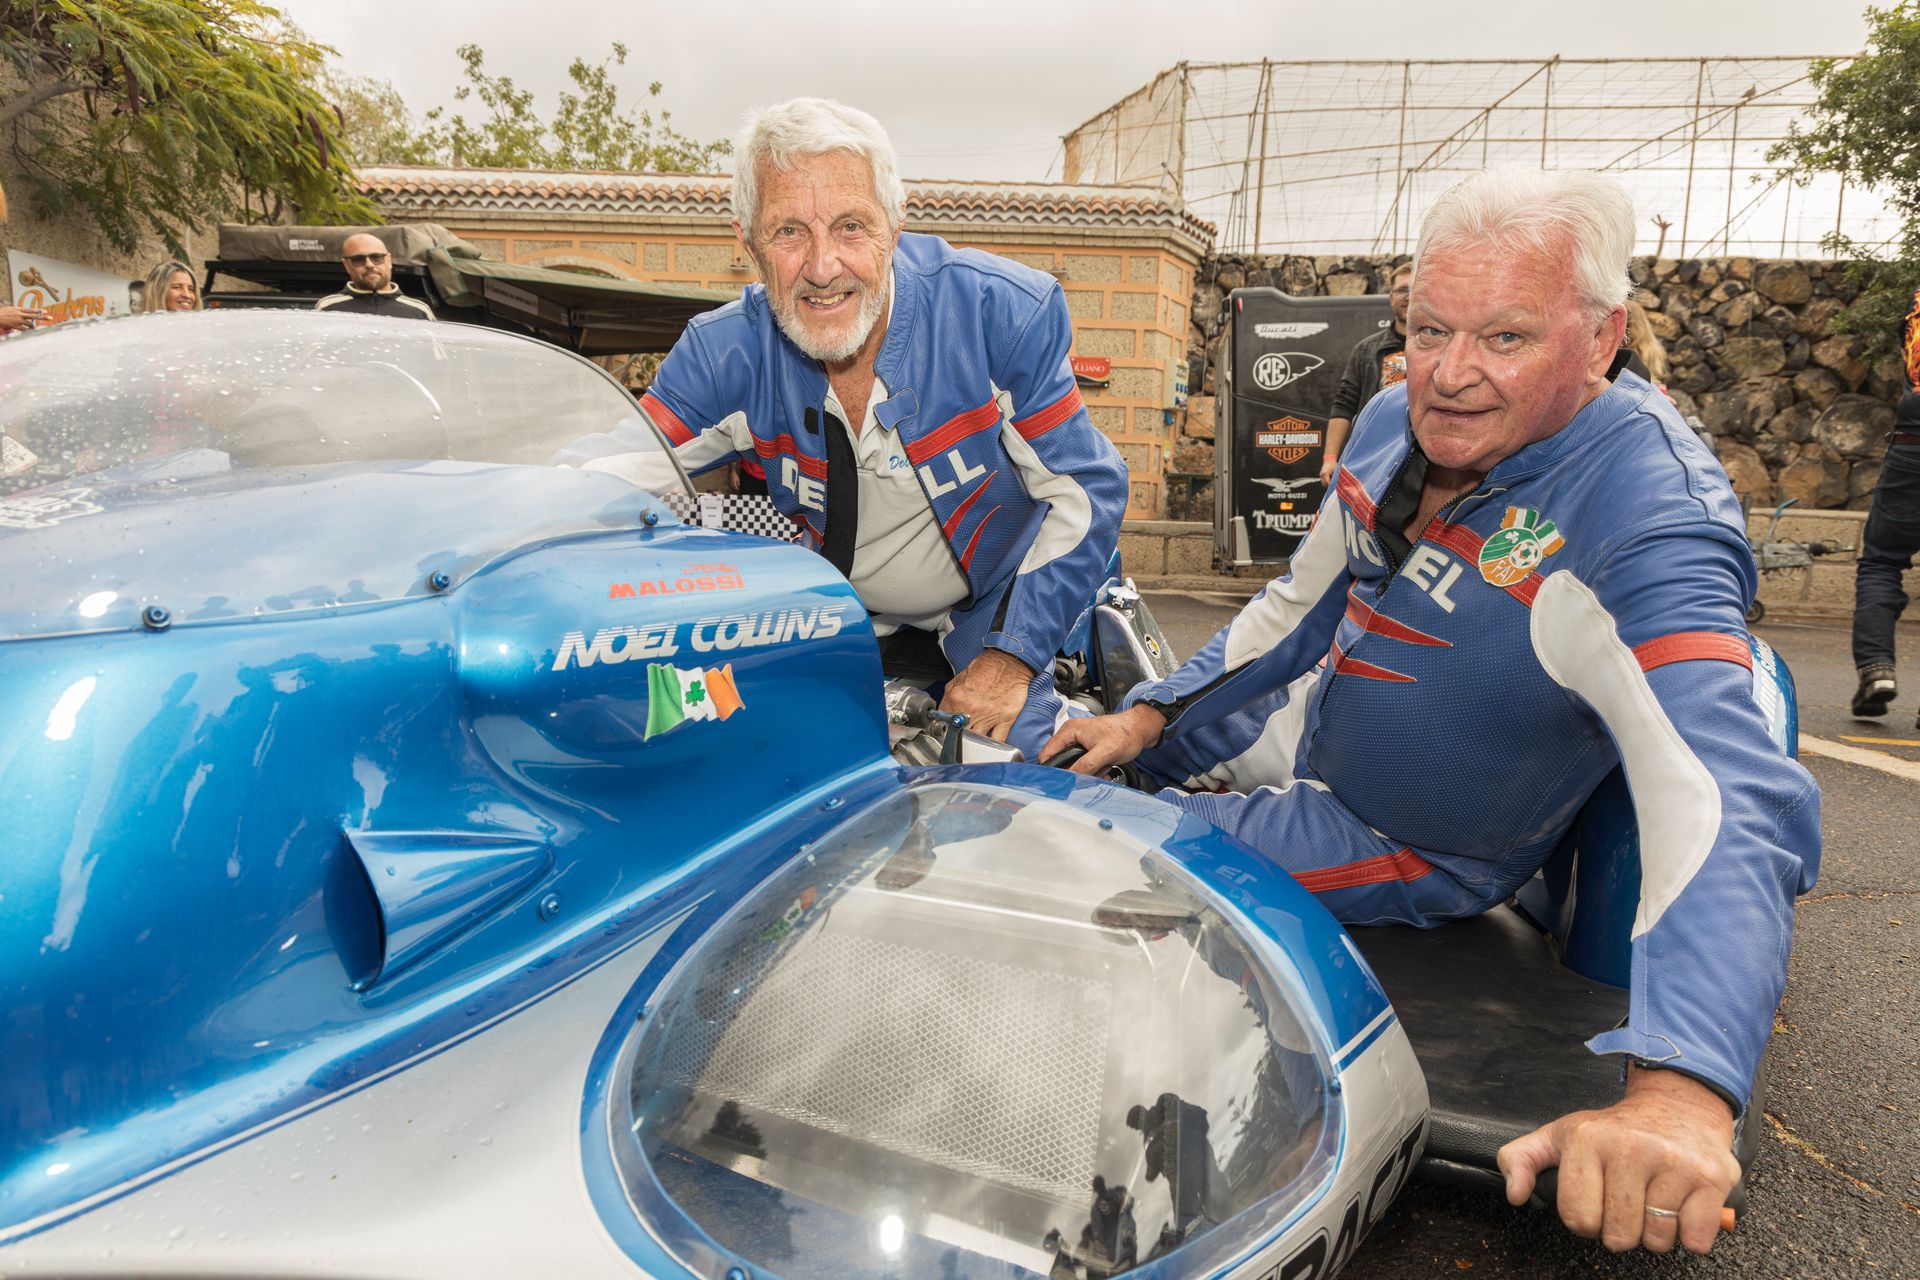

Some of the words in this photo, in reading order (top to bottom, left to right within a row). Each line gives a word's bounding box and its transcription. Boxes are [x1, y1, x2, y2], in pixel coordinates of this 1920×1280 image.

[1260, 325, 1298, 333] Ducati
[1273, 421, 1305, 430] MOTOR
[1258, 433, 1319, 446] HARLEY-DAVIDSON
[1272, 447, 1304, 460] CYCLES
[1252, 509, 1316, 529] TRIUMP
[1490, 559, 1516, 584] FAI
[608, 574, 745, 600] MALOSSI
[552, 621, 680, 671] NOEL
[690, 603, 848, 652] COLLINS
